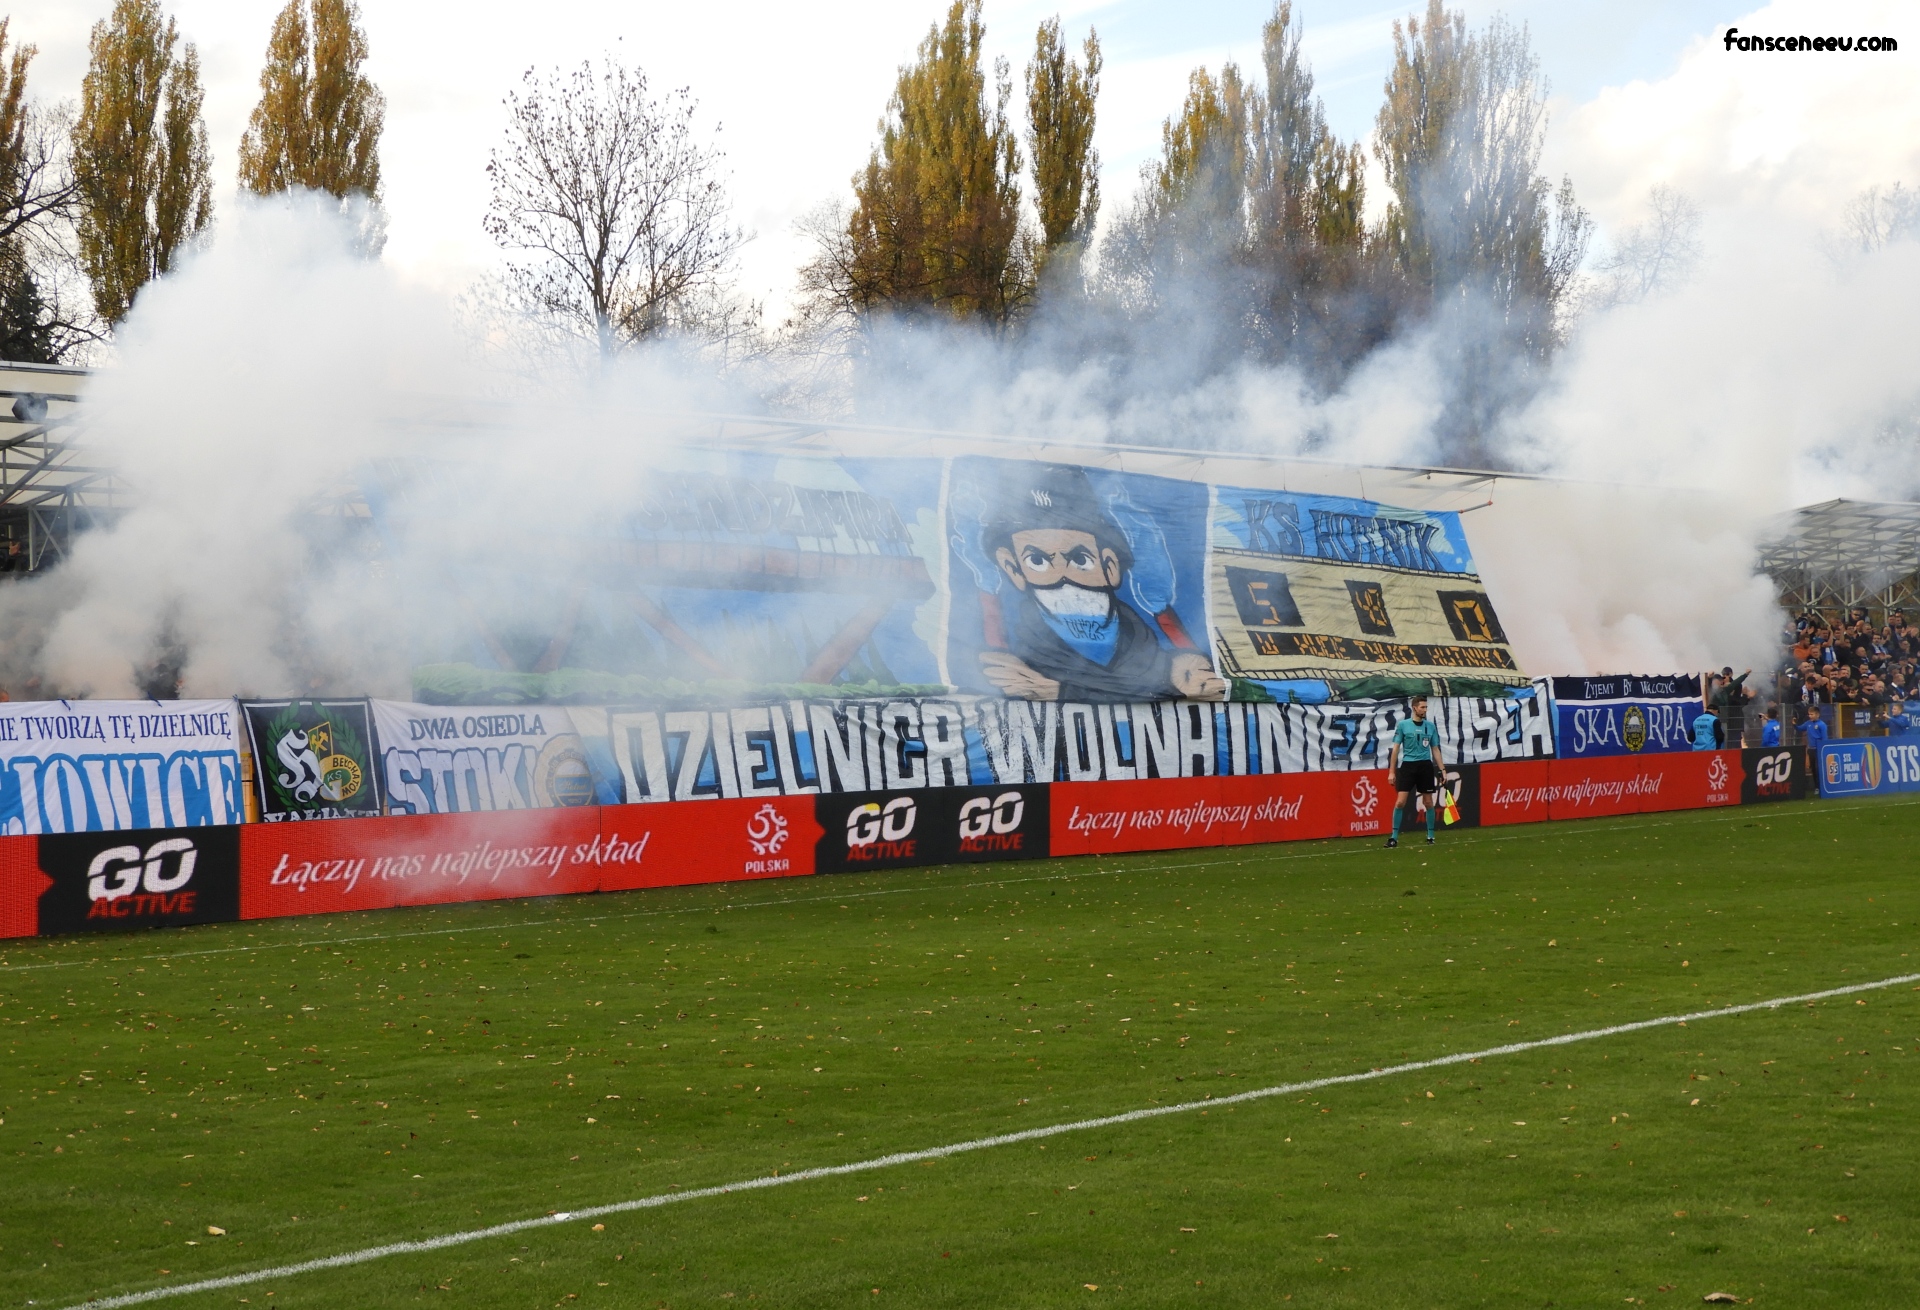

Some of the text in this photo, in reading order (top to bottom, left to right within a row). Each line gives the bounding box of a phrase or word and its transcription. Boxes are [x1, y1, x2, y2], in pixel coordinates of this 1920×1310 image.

[1242, 499, 1304, 556] KS
[0, 712, 232, 744] IE TWORZĄ TĘ DZIELNICĘ
[408, 714, 547, 741] DWA OSIEDLA
[611, 700, 969, 804] DZIELNICA
[980, 700, 1216, 784] WOLNA
[1756, 751, 1793, 787] GO
[0, 753, 241, 836] JOWICE
[1492, 773, 1663, 809] Łączy nas najlepszy skład
[1707, 793, 1729, 803] POLSKA
[1757, 782, 1792, 796] ACTIVE
[846, 796, 917, 848] GO
[958, 791, 1025, 840] GO
[1067, 795, 1304, 838] Łączy nas najlepszy skład
[1350, 820, 1379, 832] POLSKA
[847, 840, 917, 861] ACTIVE
[959, 833, 1025, 853] ACTIVE
[87, 837, 198, 901] GO
[270, 831, 651, 893] Łączy nas najlepszy skład
[745, 858, 790, 874] POLSKA
[86, 892, 199, 920] ACTIVE
